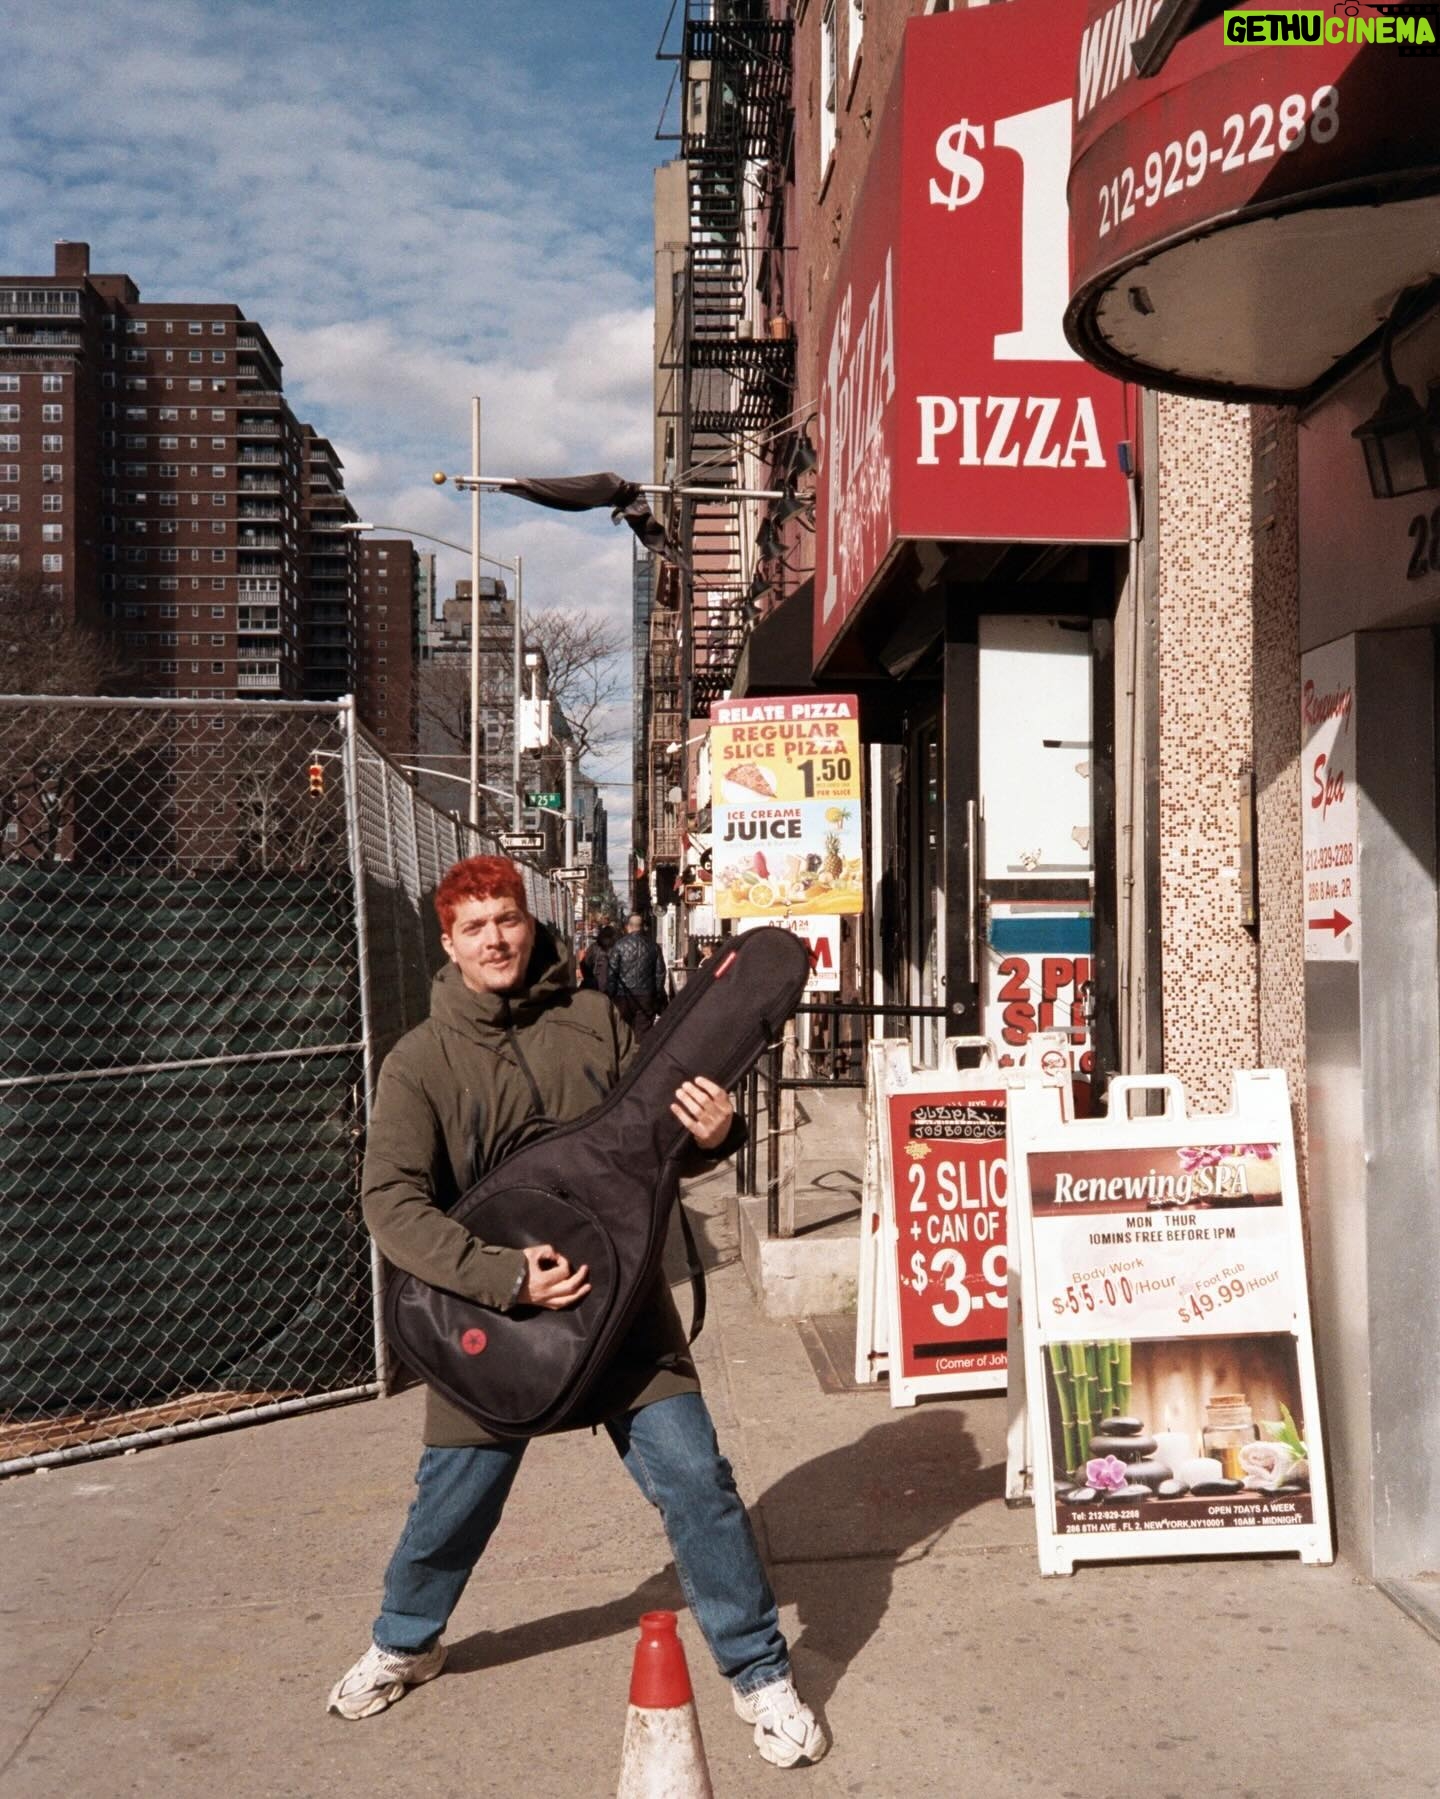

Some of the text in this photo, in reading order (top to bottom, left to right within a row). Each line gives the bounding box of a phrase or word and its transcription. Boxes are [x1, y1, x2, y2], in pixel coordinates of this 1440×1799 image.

[1098, 85, 1340, 239] 212-929-2288
[838, 246, 896, 498] PIZZA
[916, 396, 1107, 468] PIZZA
[718, 703, 851, 723] RELATE PIZZA
[1303, 679, 1353, 734] Renewing
[732, 723, 839, 742] REGULAR
[723, 740, 848, 760] SLICE PIZZA
[797, 757, 852, 798] 1.50
[1311, 753, 1345, 821] Spa
[537, 795, 548, 806] 25
[727, 808, 801, 820] ICE CREAME
[521, 837, 537, 846] WAY
[723, 819, 802, 842] JUICE
[1305, 842, 1353, 872] 212-929-2288
[997, 957, 1031, 1002] 2
[908, 1163, 927, 1212] 2
[1054, 1164, 1249, 1205] Renewing SPA
[927, 1213, 968, 1244] CAN
[973, 1211, 999, 1241] OF
[1126, 1214, 1197, 1228] MON THUR
[1089, 1227, 1236, 1245] 10MINS FREE BEFORE 1PM
[1072, 1258, 1145, 1284] Body Work
[1195, 1262, 1246, 1292] Foot Rub
[976, 1355, 987, 1367] of
[1071, 1511, 1087, 1521] Tel:
[1208, 1503, 1296, 1515] OPEN 7DAYS A WEEK
[1122, 1522, 1133, 1531] FL
[1144, 1520, 1164, 1530] NEW
[1233, 1518, 1256, 1527] 10AM
[1262, 1515, 1302, 1525] MIDNIGHT
